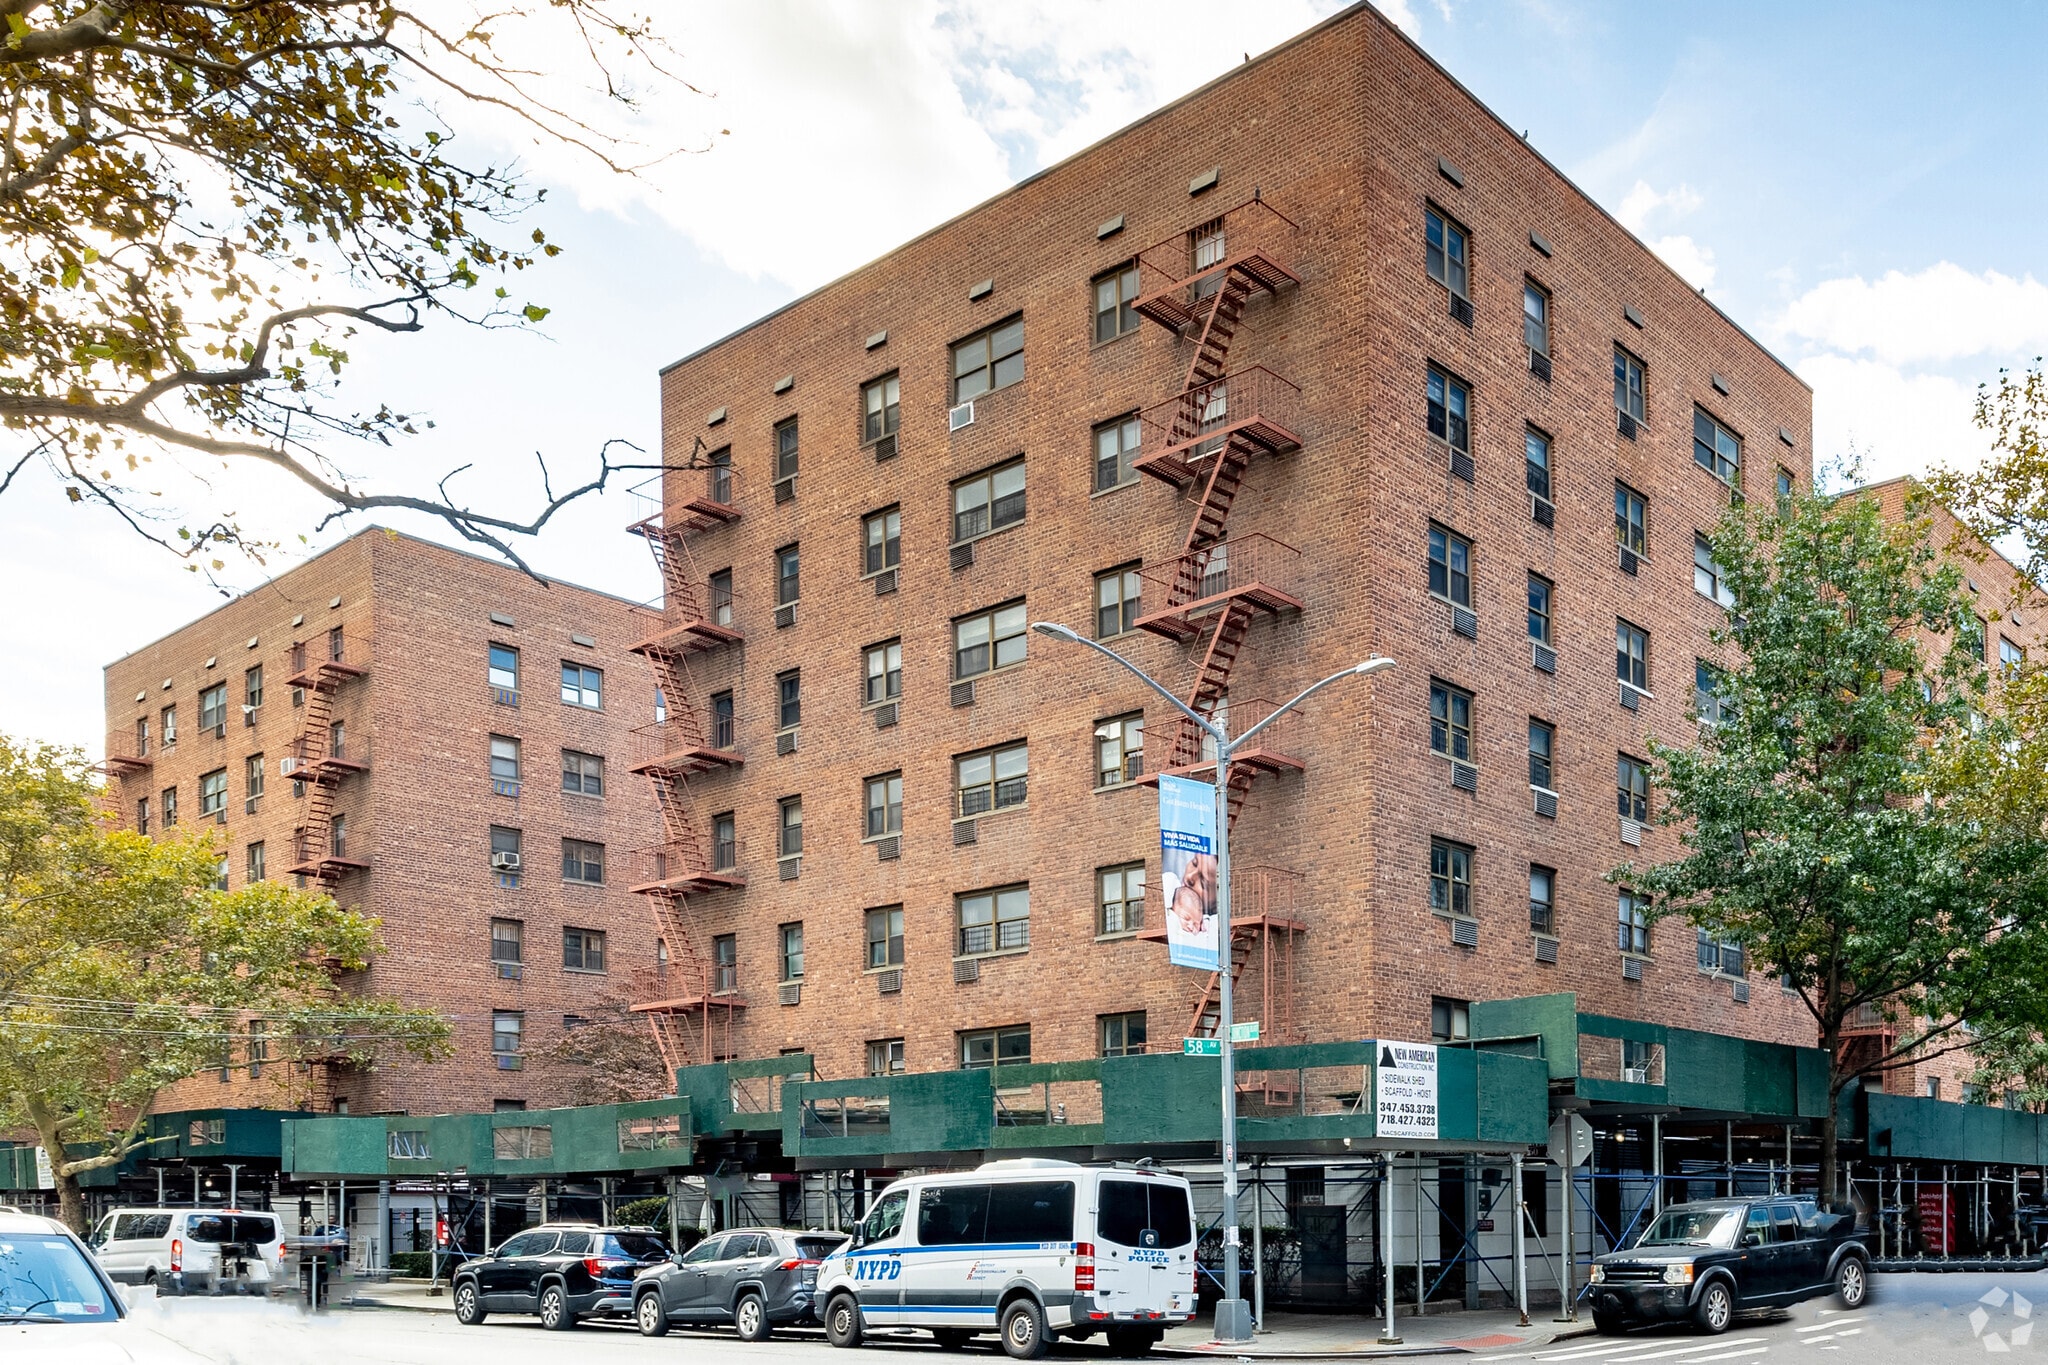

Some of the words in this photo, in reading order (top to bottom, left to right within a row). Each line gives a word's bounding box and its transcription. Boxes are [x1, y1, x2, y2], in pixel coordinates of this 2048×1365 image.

[1163, 831, 1178, 839] VIVA
[1164, 838, 1178, 846] MÁS
[1179, 841, 1208, 852] SALUDABLE
[1188, 1040, 1203, 1053] 58
[1394, 1047, 1407, 1060] NEW
[1408, 1049, 1435, 1063] AMERICAN
[1398, 1061, 1428, 1070] CONSTRUCTION
[1385, 1073, 1411, 1084] SIDEWALK
[1412, 1075, 1426, 1086] SHED
[1385, 1086, 1412, 1097] SCAFFOLD
[1417, 1089, 1431, 1098] HOIST
[1380, 1102, 1435, 1114] 347.453.3738
[1380, 1114, 1435, 1126] 718.427.4323
[1128, 1255, 1170, 1263] POLICE
[1133, 1249, 1165, 1257] NYPD
[855, 1260, 902, 1280] NYPD
